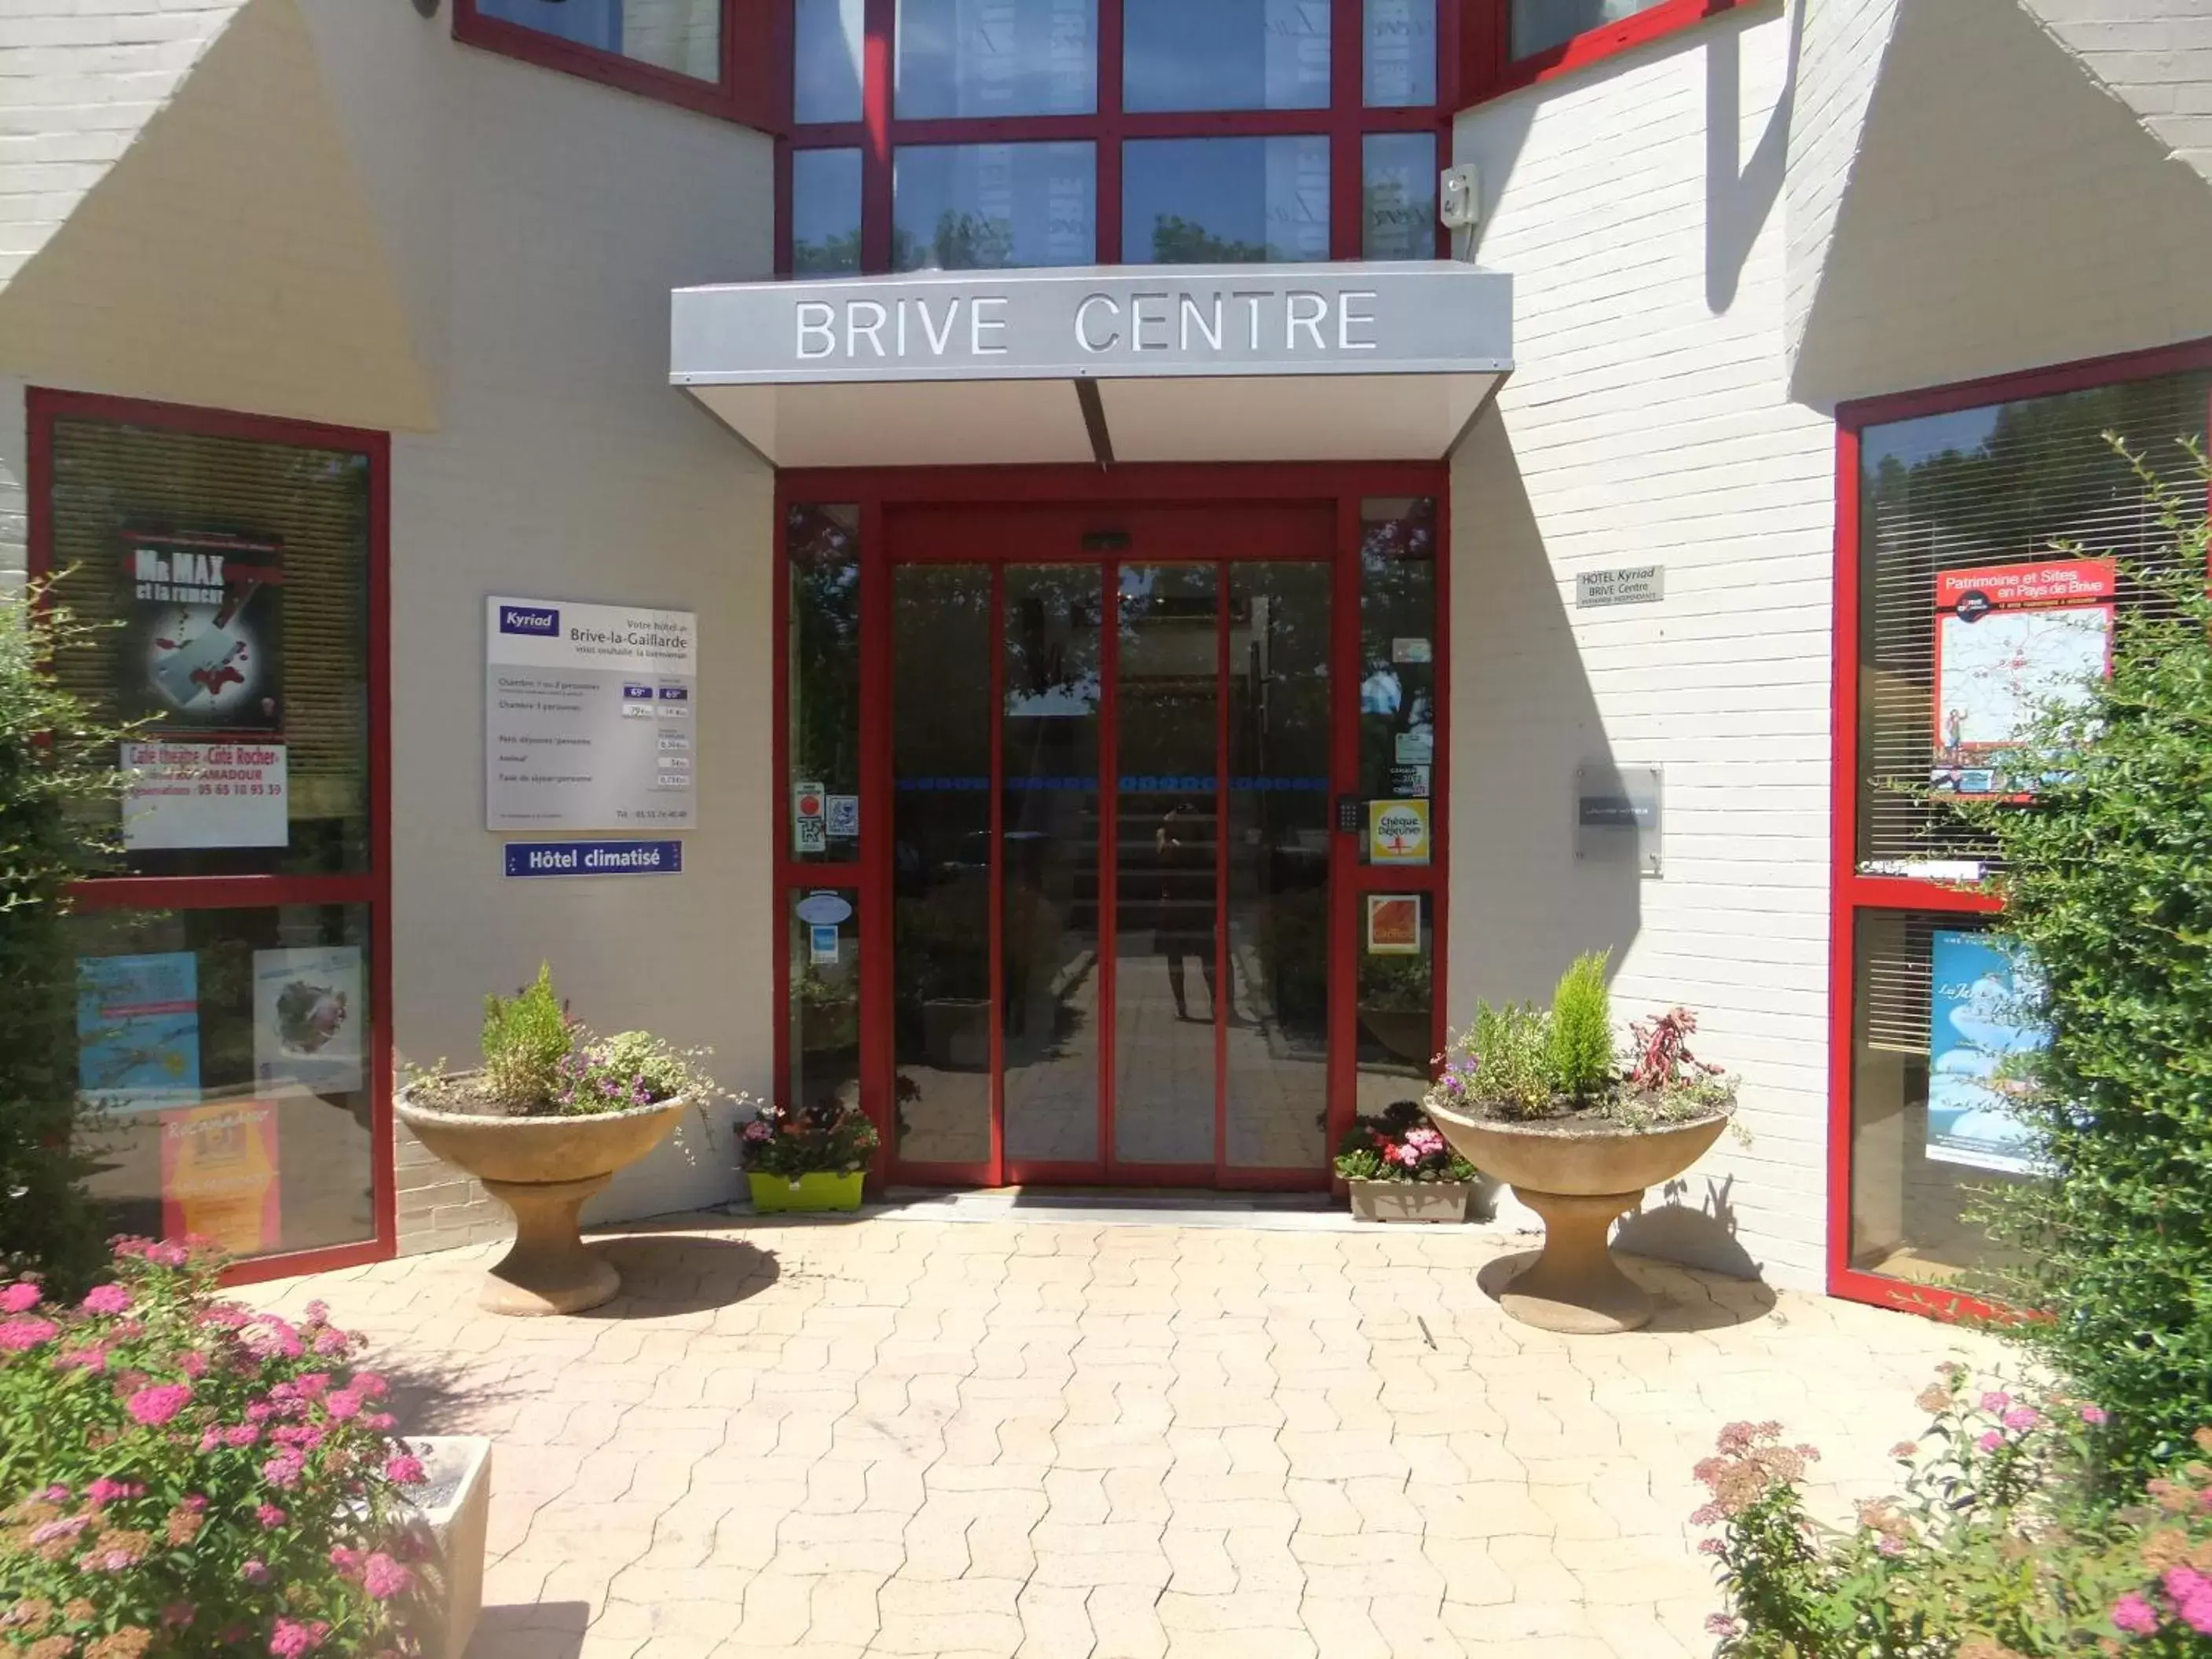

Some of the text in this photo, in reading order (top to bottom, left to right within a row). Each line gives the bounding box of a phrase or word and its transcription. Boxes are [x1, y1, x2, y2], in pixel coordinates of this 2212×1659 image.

[796, 289, 1378, 360] BRIVE CENTRE
[172, 551, 225, 586] MAX
[1617, 566, 1655, 582] Kyriad
[1588, 582, 1649, 596] BRIVE Centre
[1945, 569, 2078, 589] Patrimoine et Sites
[1998, 580, 2104, 599] en Pays de Brive
[506, 611, 552, 628] Kyriad
[570, 628, 688, 648] Brive-la-Gaillarde
[529, 847, 661, 869] Hôtel climatisé
